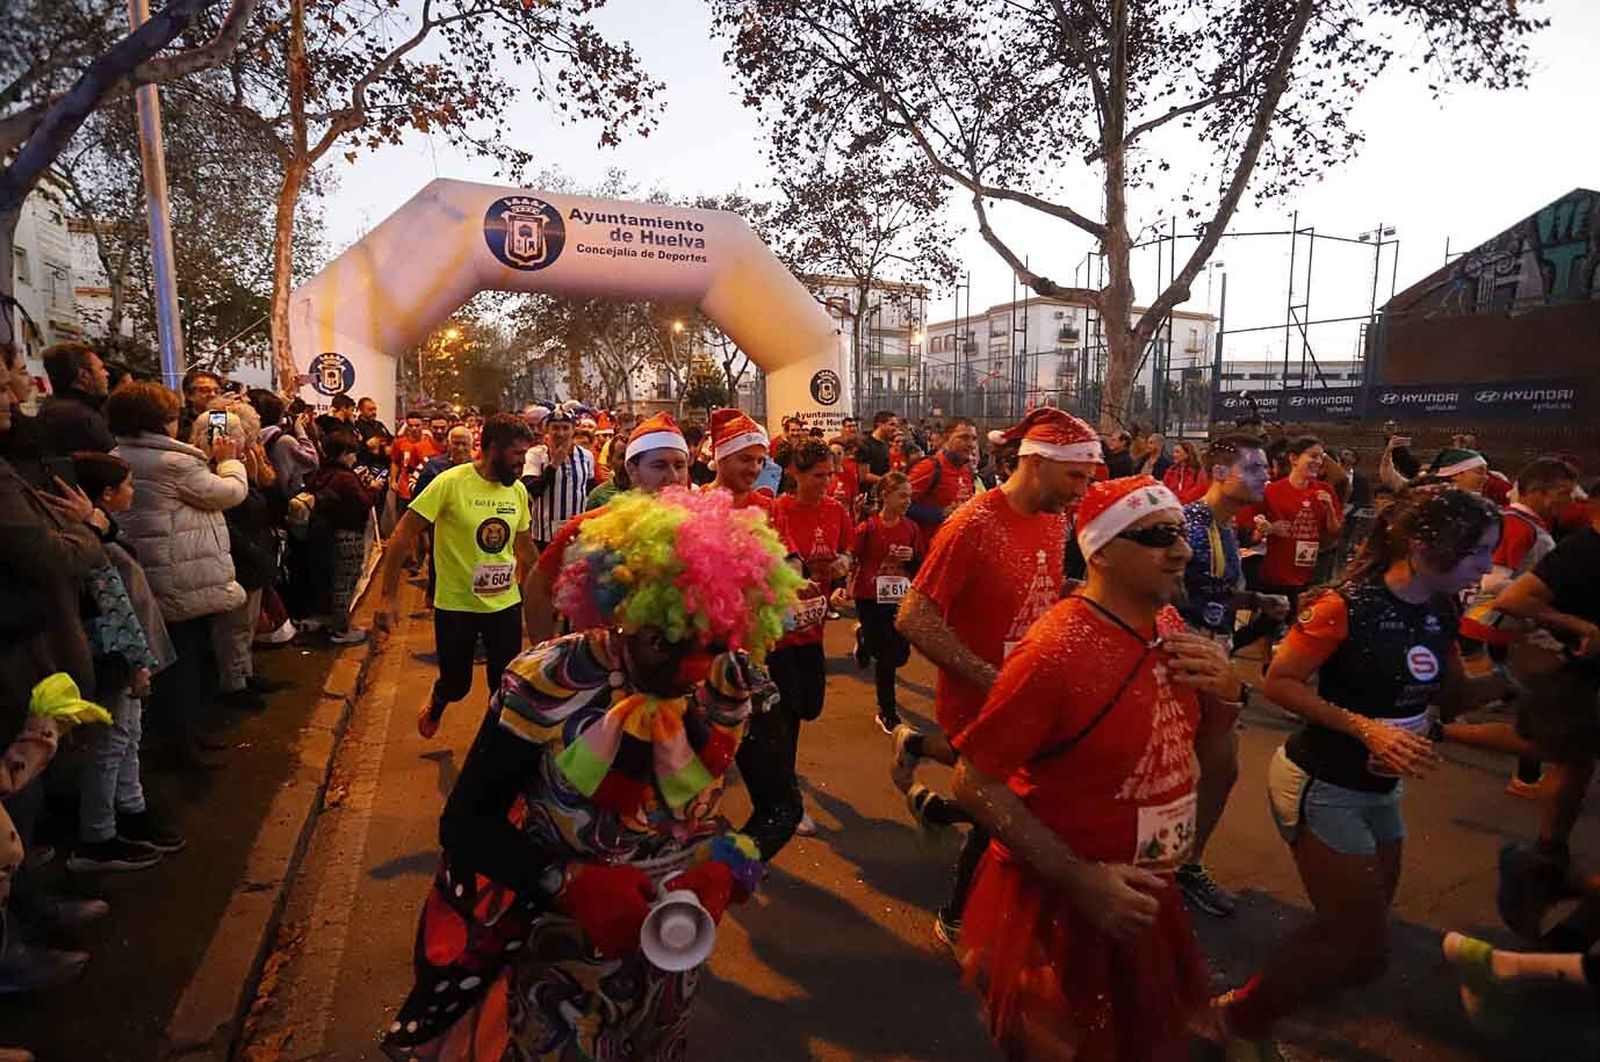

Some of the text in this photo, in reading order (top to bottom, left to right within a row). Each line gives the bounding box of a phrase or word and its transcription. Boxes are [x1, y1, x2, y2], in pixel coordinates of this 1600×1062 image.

[569, 208, 704, 232] Ayuntamiento
[610, 228, 705, 249] de Huelva
[641, 250, 655, 259] de
[658, 250, 707, 263] Deportes
[1307, 396, 1353, 405] HYUNDAI
[1402, 393, 1459, 402] HYUNDAI
[1503, 389, 1574, 400] HYUNDAI
[492, 573, 511, 585] 604
